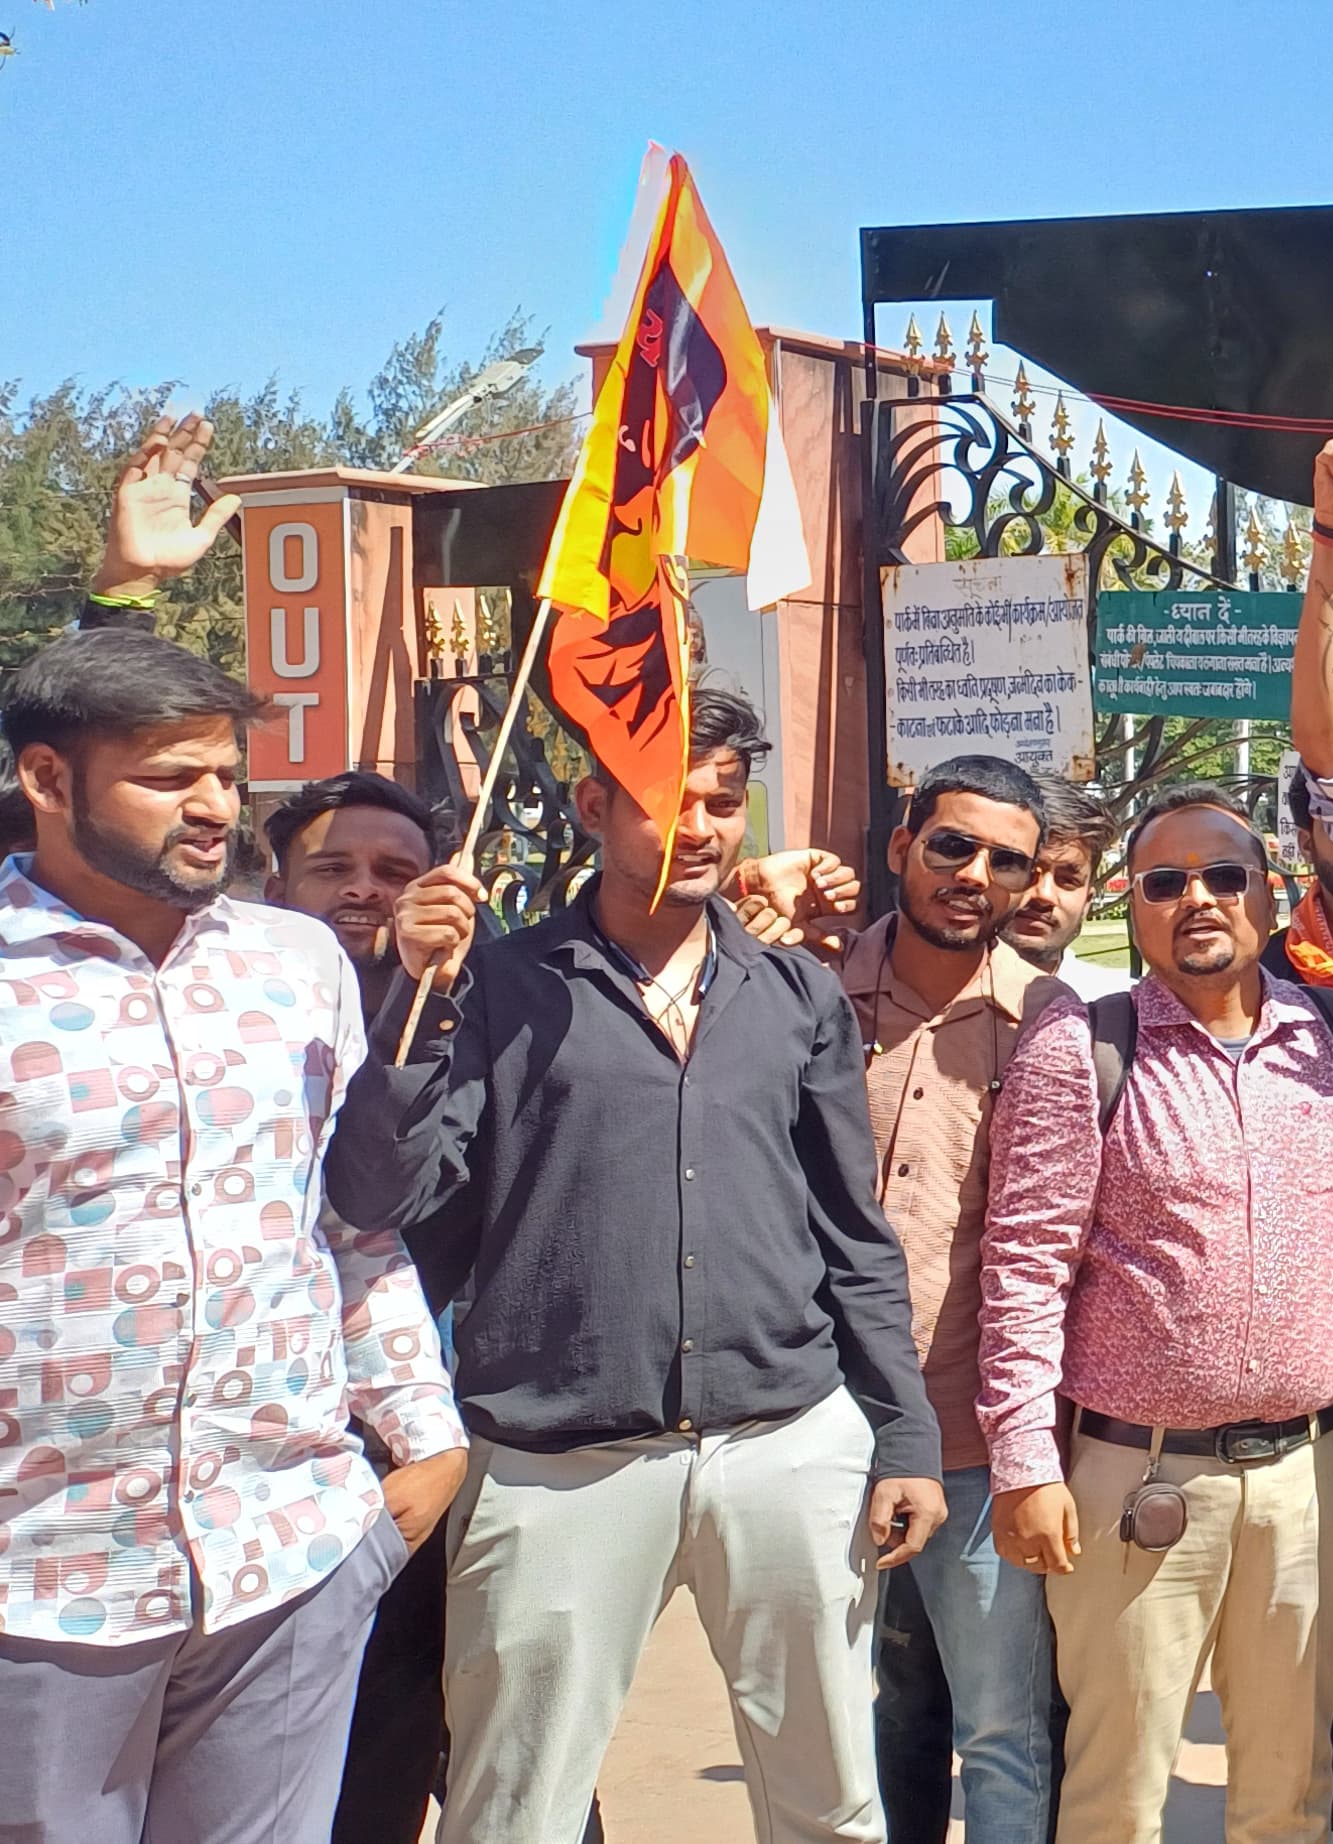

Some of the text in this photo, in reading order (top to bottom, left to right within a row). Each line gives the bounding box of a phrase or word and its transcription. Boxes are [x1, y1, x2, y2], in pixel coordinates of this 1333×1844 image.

[940, 602, 974, 635] अनुमति
[269, 522, 321, 763] OUT
[1023, 710, 1044, 733] मना
